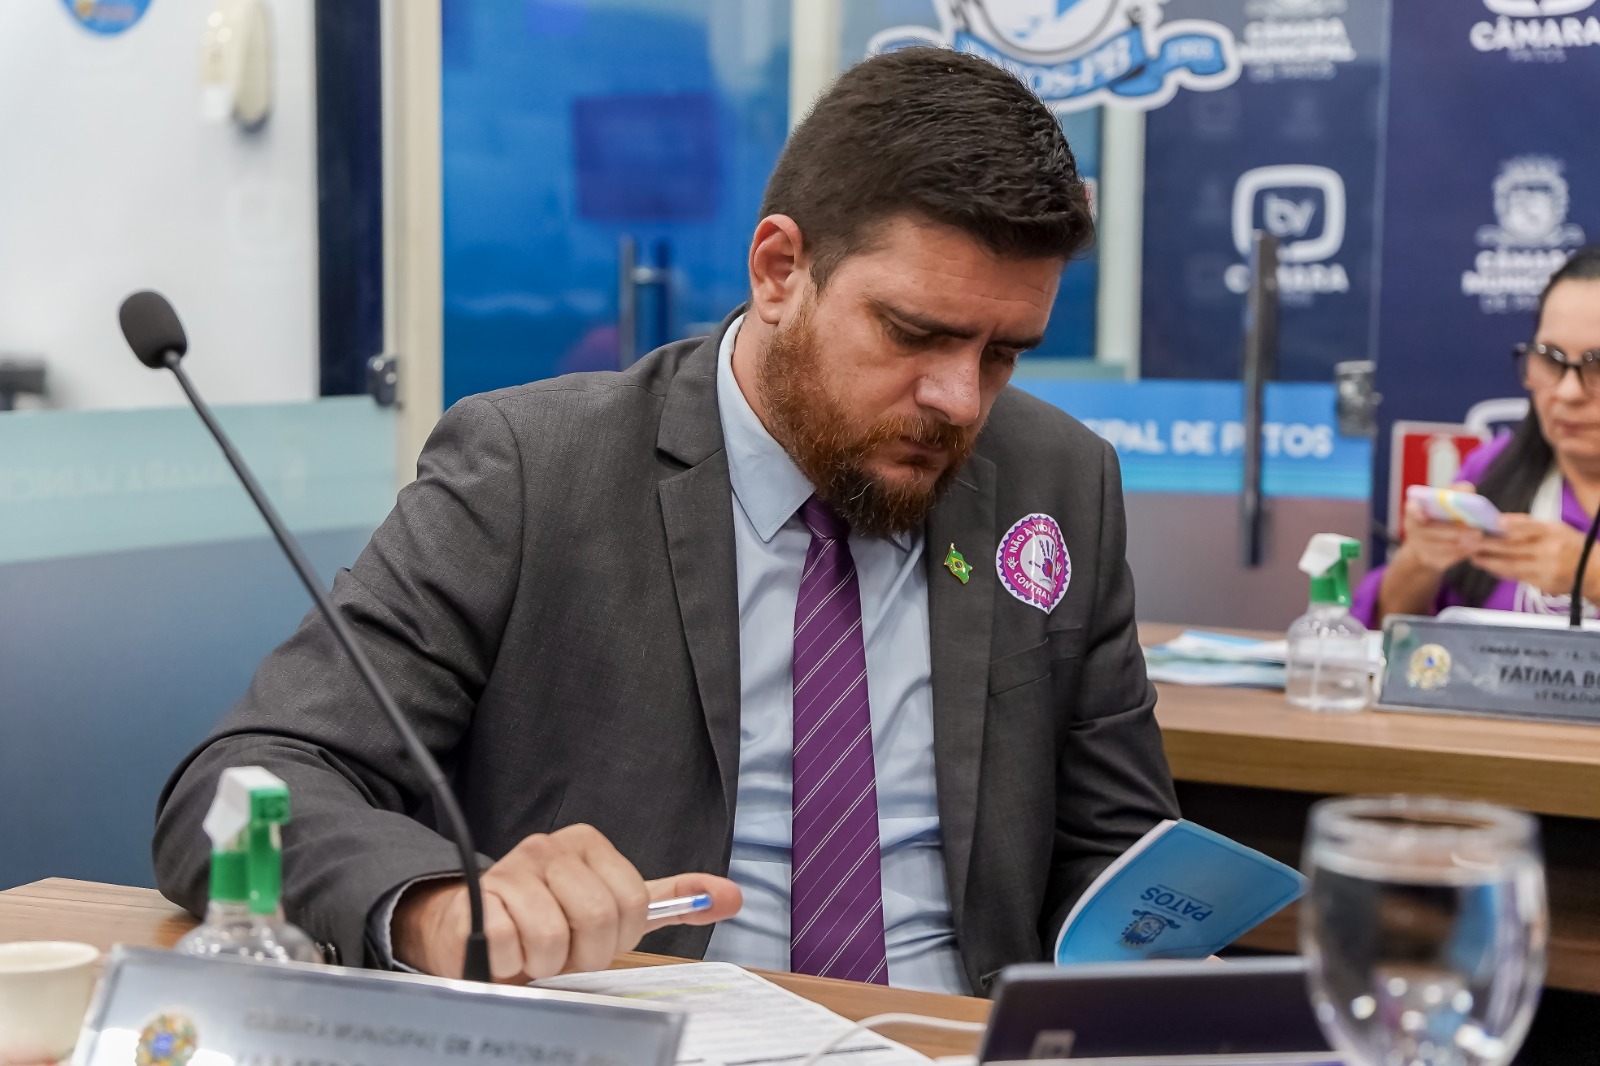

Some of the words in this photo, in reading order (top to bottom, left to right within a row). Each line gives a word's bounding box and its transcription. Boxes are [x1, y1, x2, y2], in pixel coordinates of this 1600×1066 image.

[1224, 262, 1349, 294] CMARA
[1171, 420, 1215, 455] DE
[1220, 421, 1334, 458] PTOS
[1009, 534, 1025, 553] NÃO
[1013, 572, 1049, 598] CONTRA
[1140, 887, 1213, 922] PATOS
